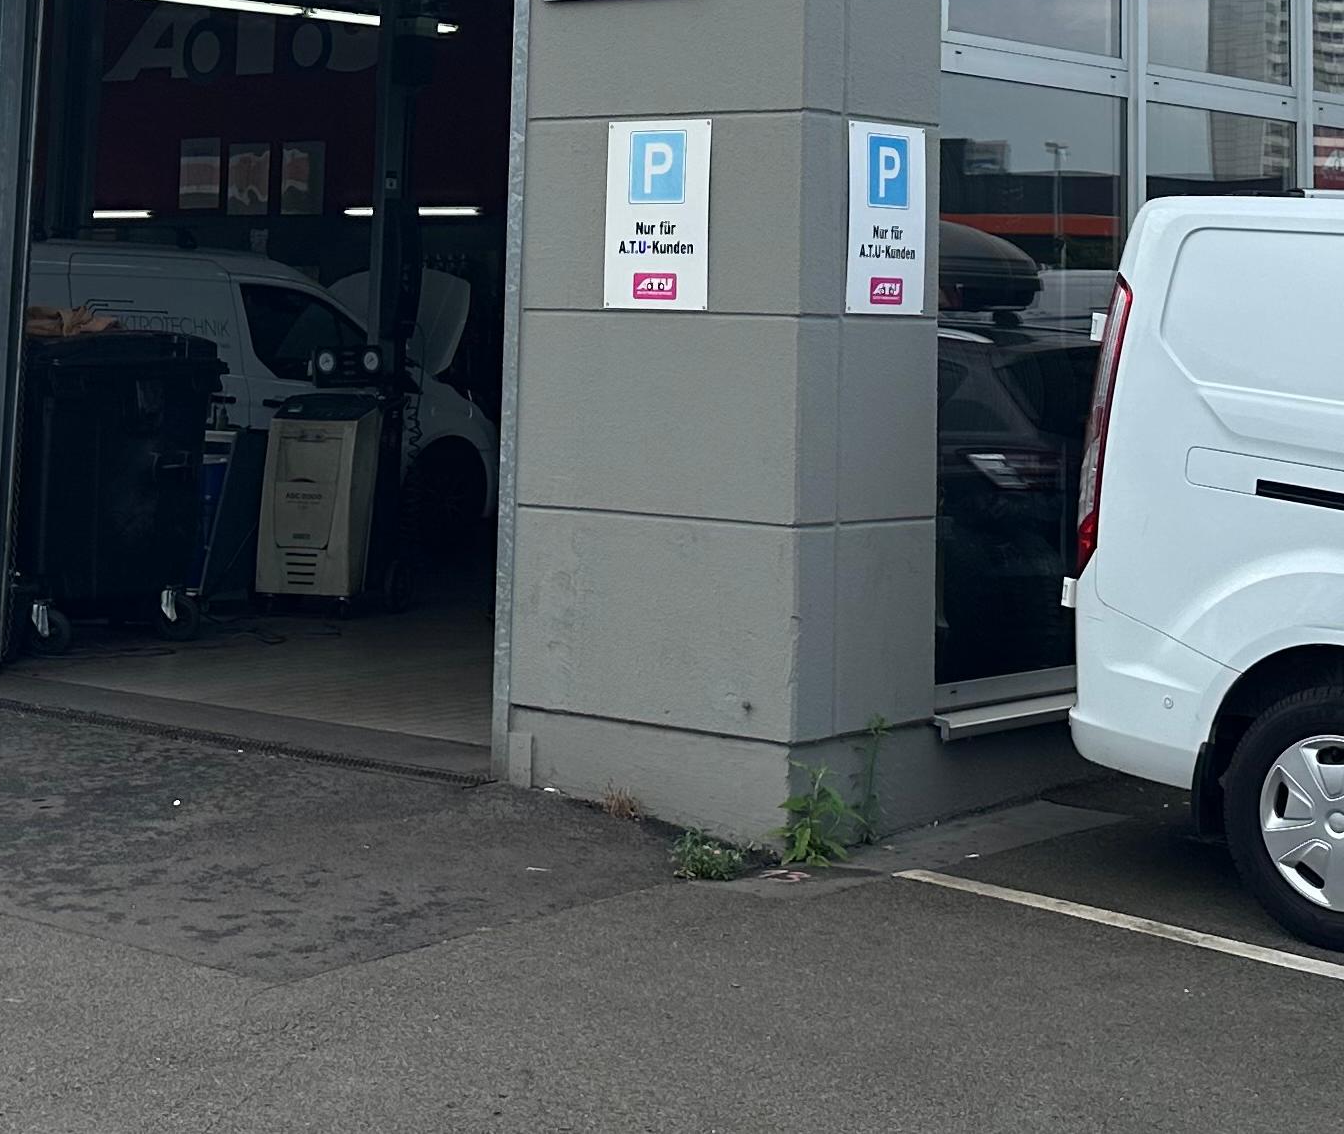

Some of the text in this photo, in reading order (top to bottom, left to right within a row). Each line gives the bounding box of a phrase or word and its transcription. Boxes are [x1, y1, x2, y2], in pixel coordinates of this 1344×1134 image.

[644, 143, 673, 194] P
[879, 146, 901, 198] P
[635, 220, 676, 235] Nur für
[873, 224, 904, 241] Nur für
[619, 240, 694, 255] A.T.U-Kunden
[859, 243, 916, 260] A.T.U-Kunden
